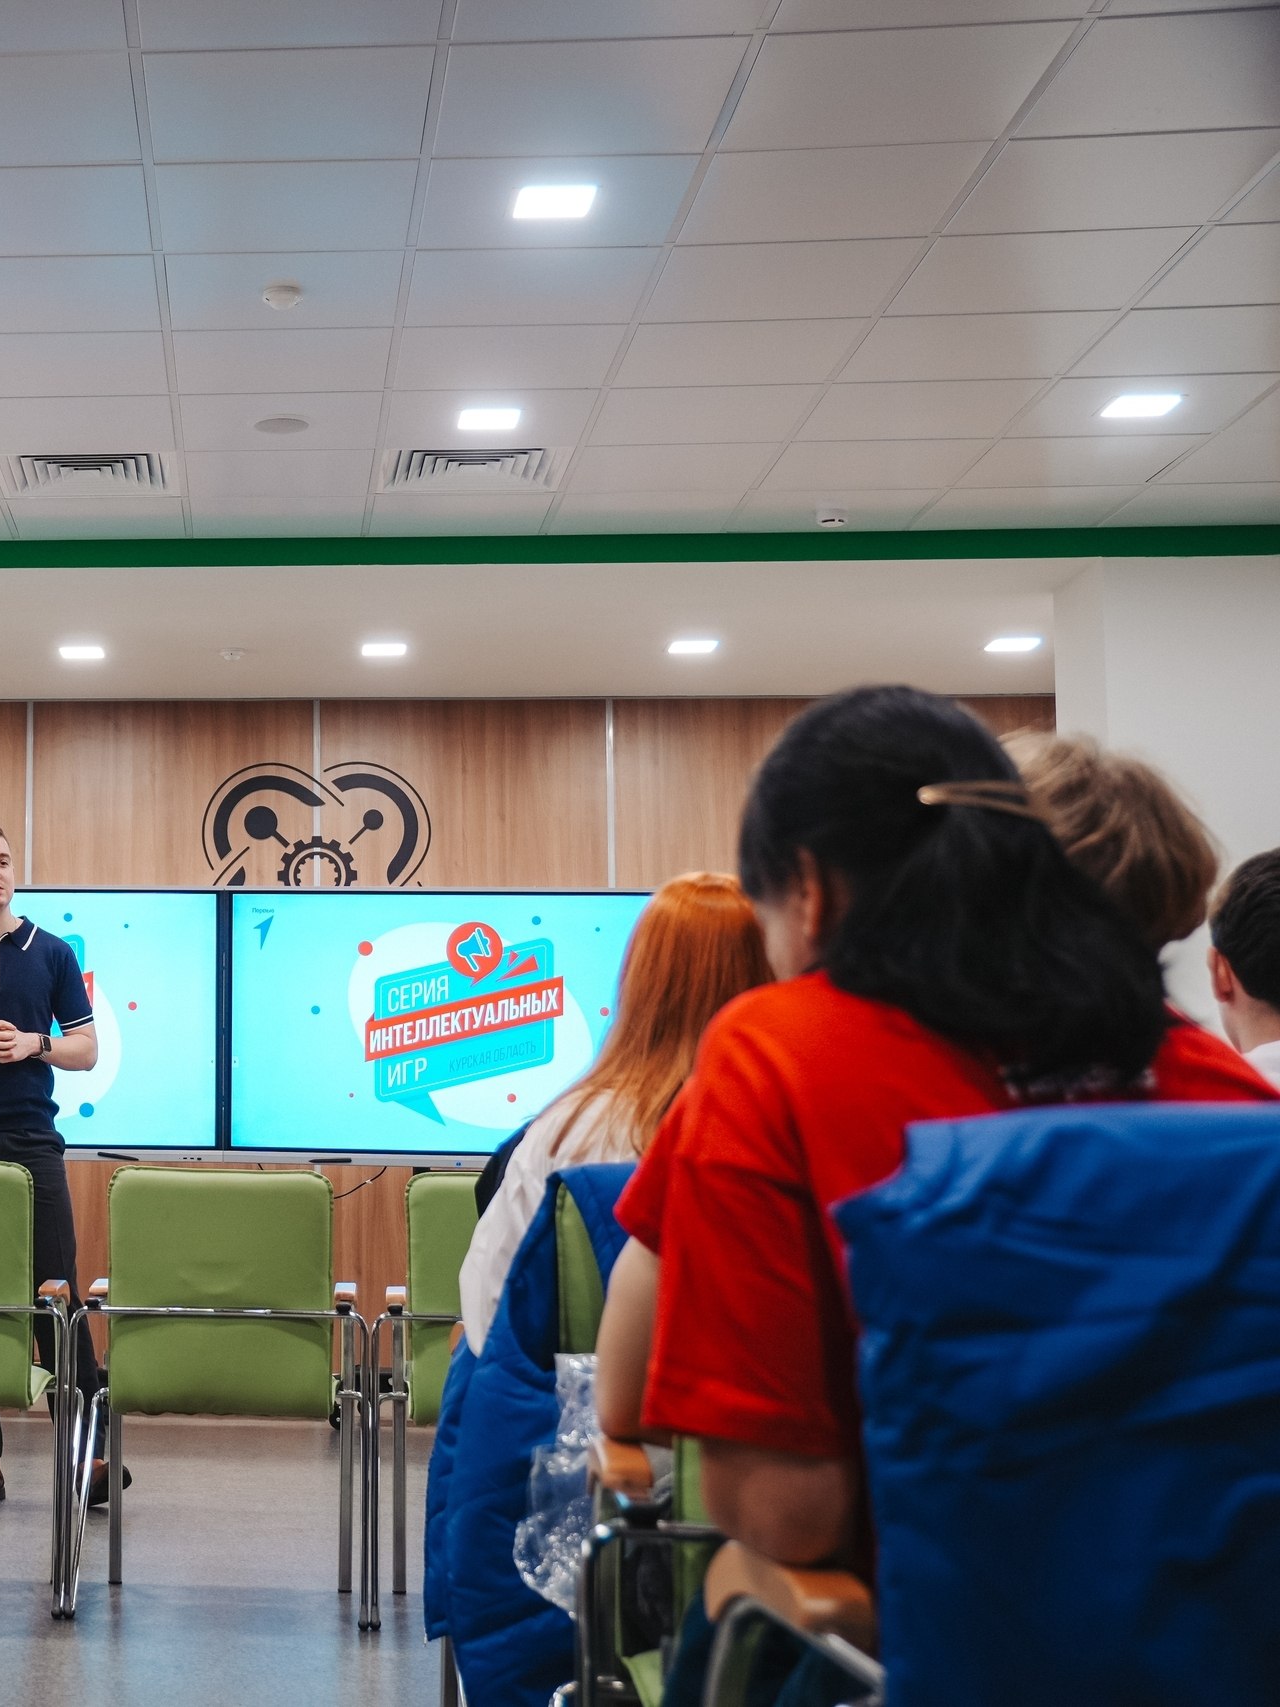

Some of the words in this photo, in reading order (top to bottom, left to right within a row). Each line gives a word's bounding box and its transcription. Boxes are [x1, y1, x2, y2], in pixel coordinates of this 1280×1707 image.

[387, 975, 449, 1013] СЕРИЯ
[369, 987, 560, 1053] ИНТЕЛЛЕКТУАЛЬНЫХ
[387, 1057, 428, 1088] ИГР
[449, 1050, 492, 1073] КУРСКАЯ
[493, 1040, 537, 1063] ОБЛАСТЬ
